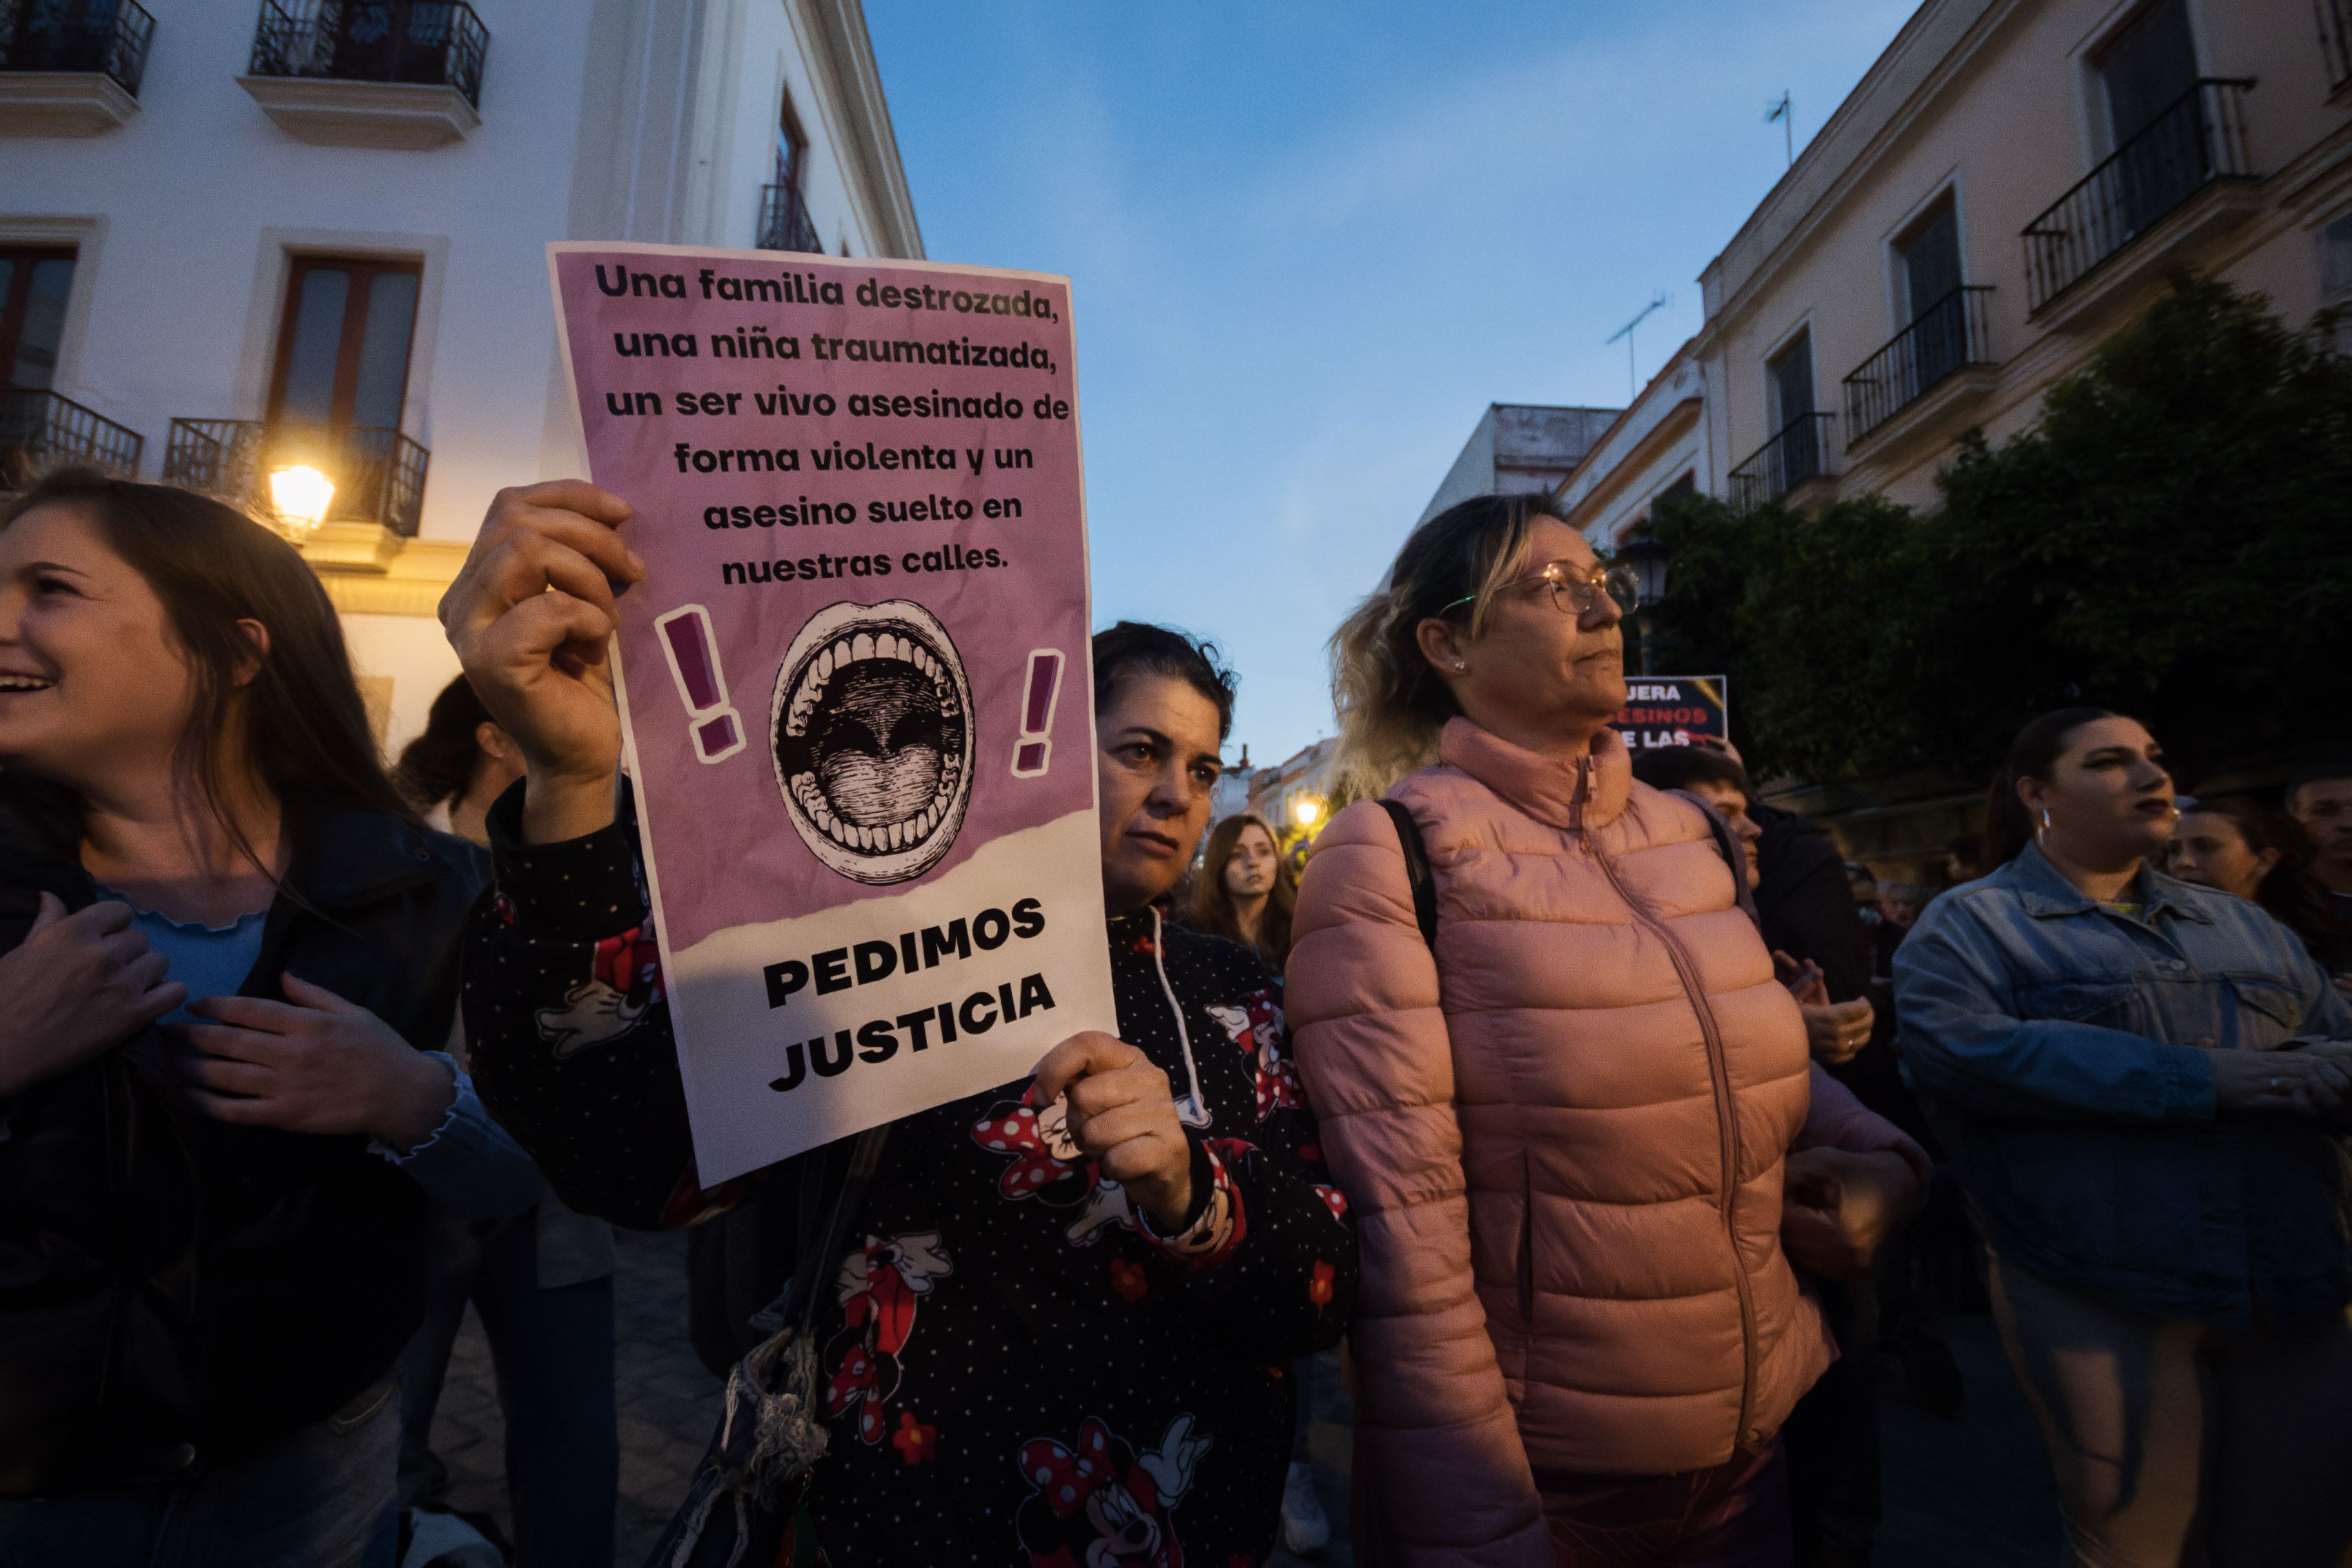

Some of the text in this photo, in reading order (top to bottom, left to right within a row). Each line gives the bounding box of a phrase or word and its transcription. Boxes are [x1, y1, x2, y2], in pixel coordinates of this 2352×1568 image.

[596, 265, 1058, 322] Una familia destrozada,
[614, 326, 1056, 373] una niña traumatizada,
[606, 384, 1068, 420] un ser vivo asesinado de
[674, 441, 1032, 476] forma violenta y un
[703, 494, 1021, 529] asesino suelto en
[723, 545, 1008, 585] nuestras calles.
[1627, 685, 1680, 701] UERA
[1616, 707, 1708, 725] ESINOS
[1621, 729, 1691, 749] E LAS
[763, 897, 1045, 1009] PEDIMOS
[768, 972, 1056, 1092] JUSTICIA
